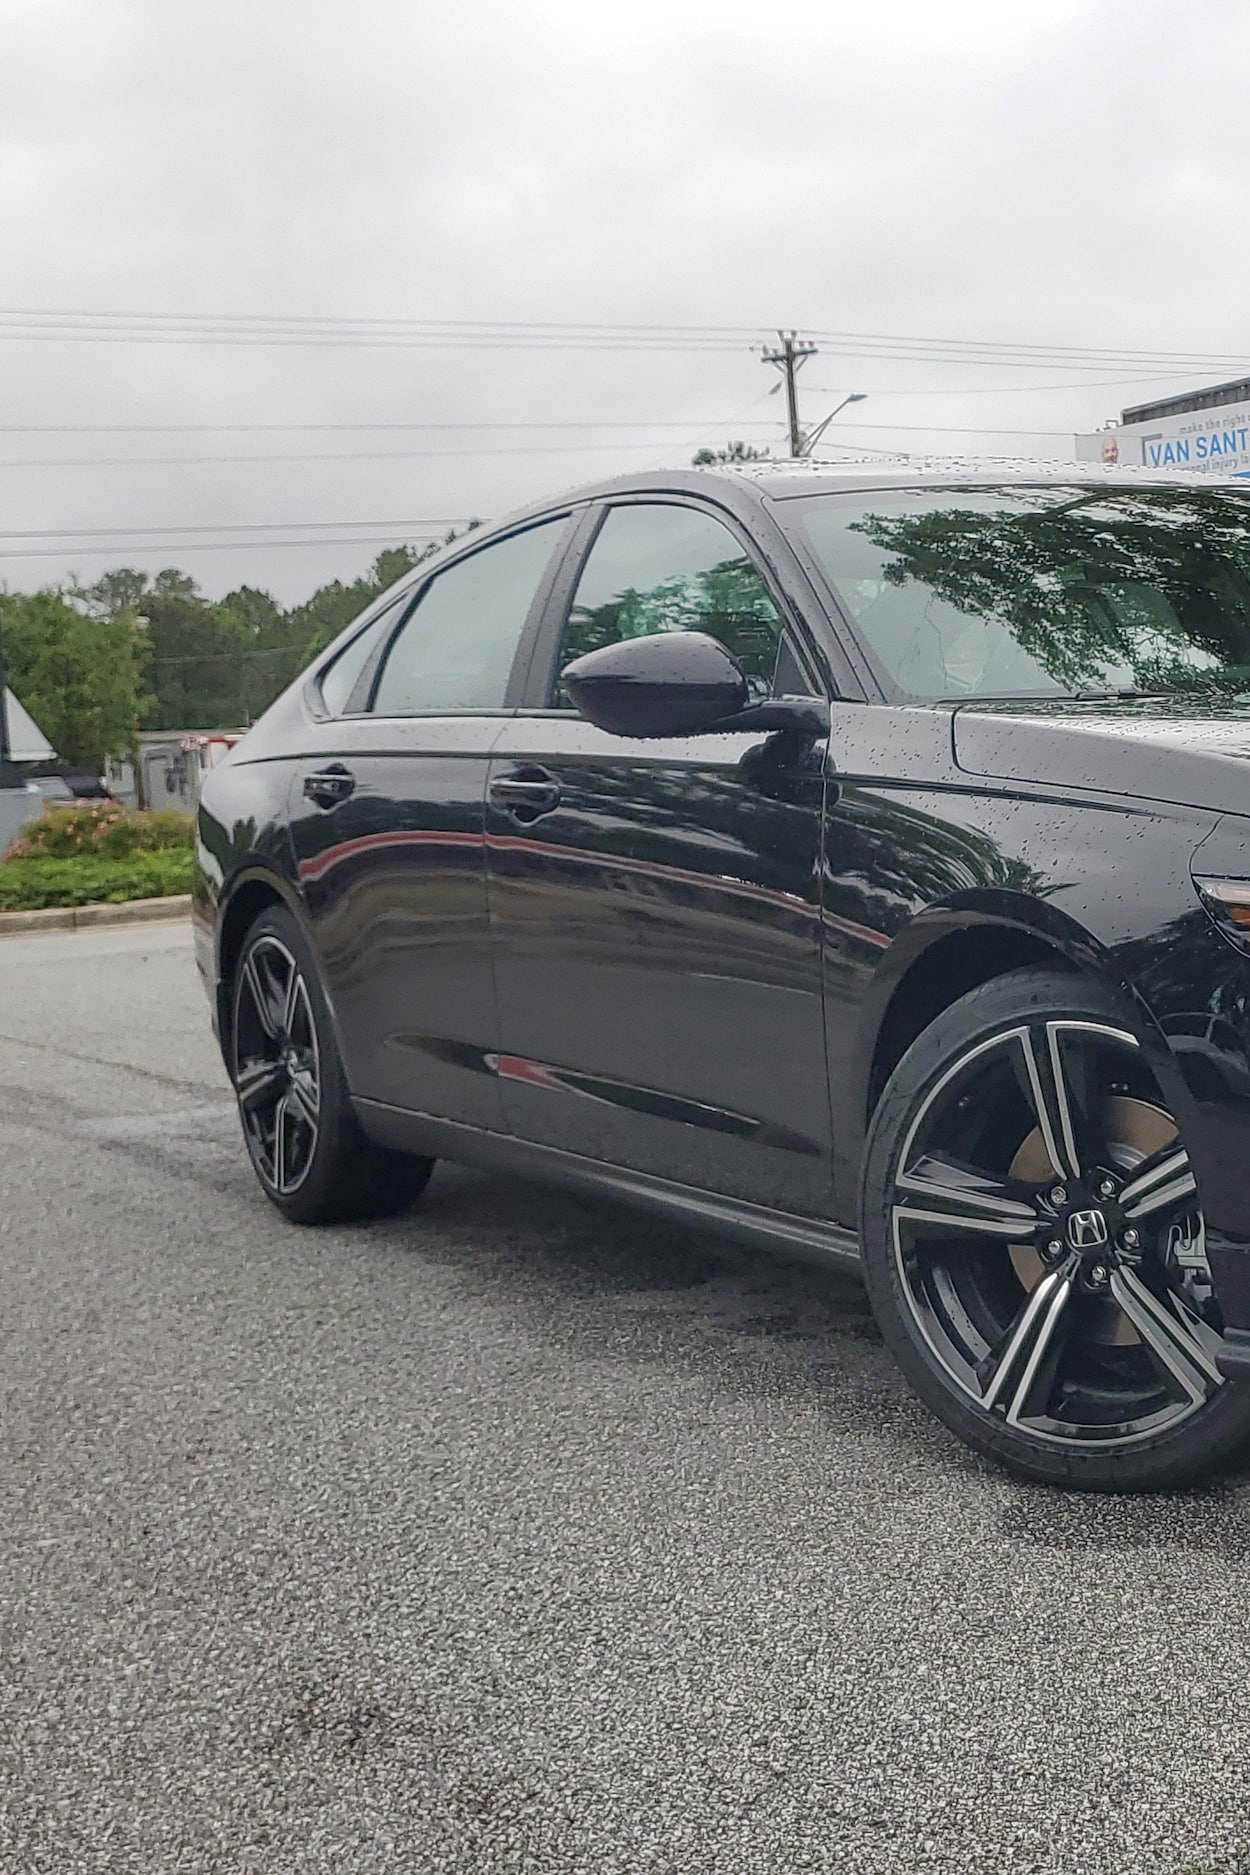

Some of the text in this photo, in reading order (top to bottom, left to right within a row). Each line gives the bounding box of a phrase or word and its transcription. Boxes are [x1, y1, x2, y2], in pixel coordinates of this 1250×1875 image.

[1179, 422, 1203, 434] make
[1205, 419, 1220, 430] the
[1222, 413, 1246, 428] right
[1149, 439, 1191, 467] VAN
[1195, 427, 1249, 459] SANT
[1211, 457, 1238, 472] injury
